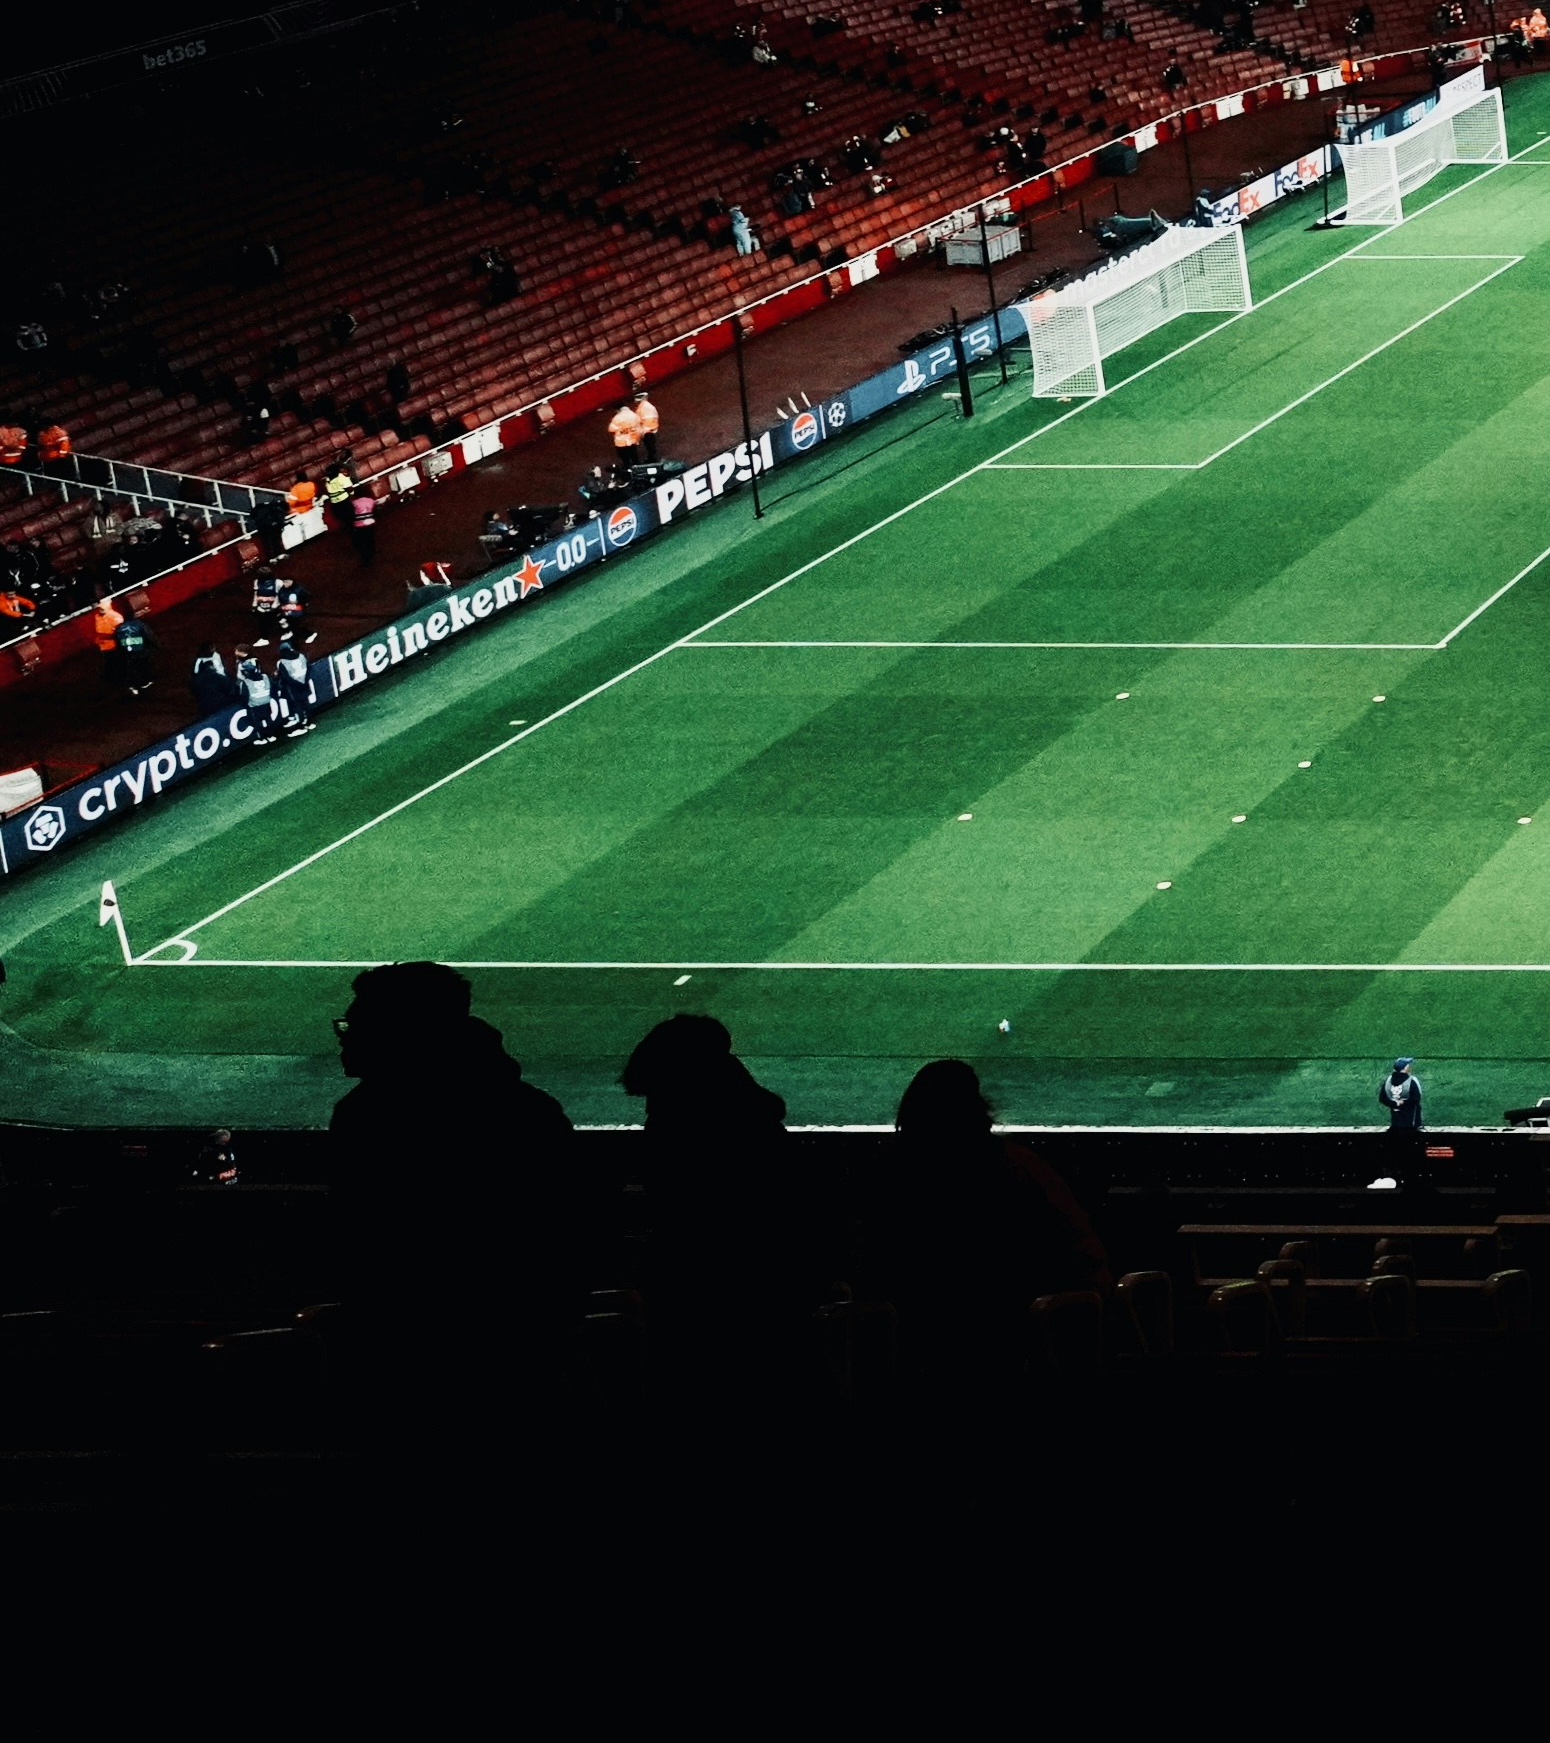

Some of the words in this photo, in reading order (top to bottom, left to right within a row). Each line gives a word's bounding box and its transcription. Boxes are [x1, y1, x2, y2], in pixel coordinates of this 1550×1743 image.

[142, 39, 207, 70] bet365
[794, 424, 815, 440] PEPSI
[655, 431, 774, 525] PEPSI
[610, 517, 635, 535] PEPSI
[333, 575, 519, 692] Heineken
